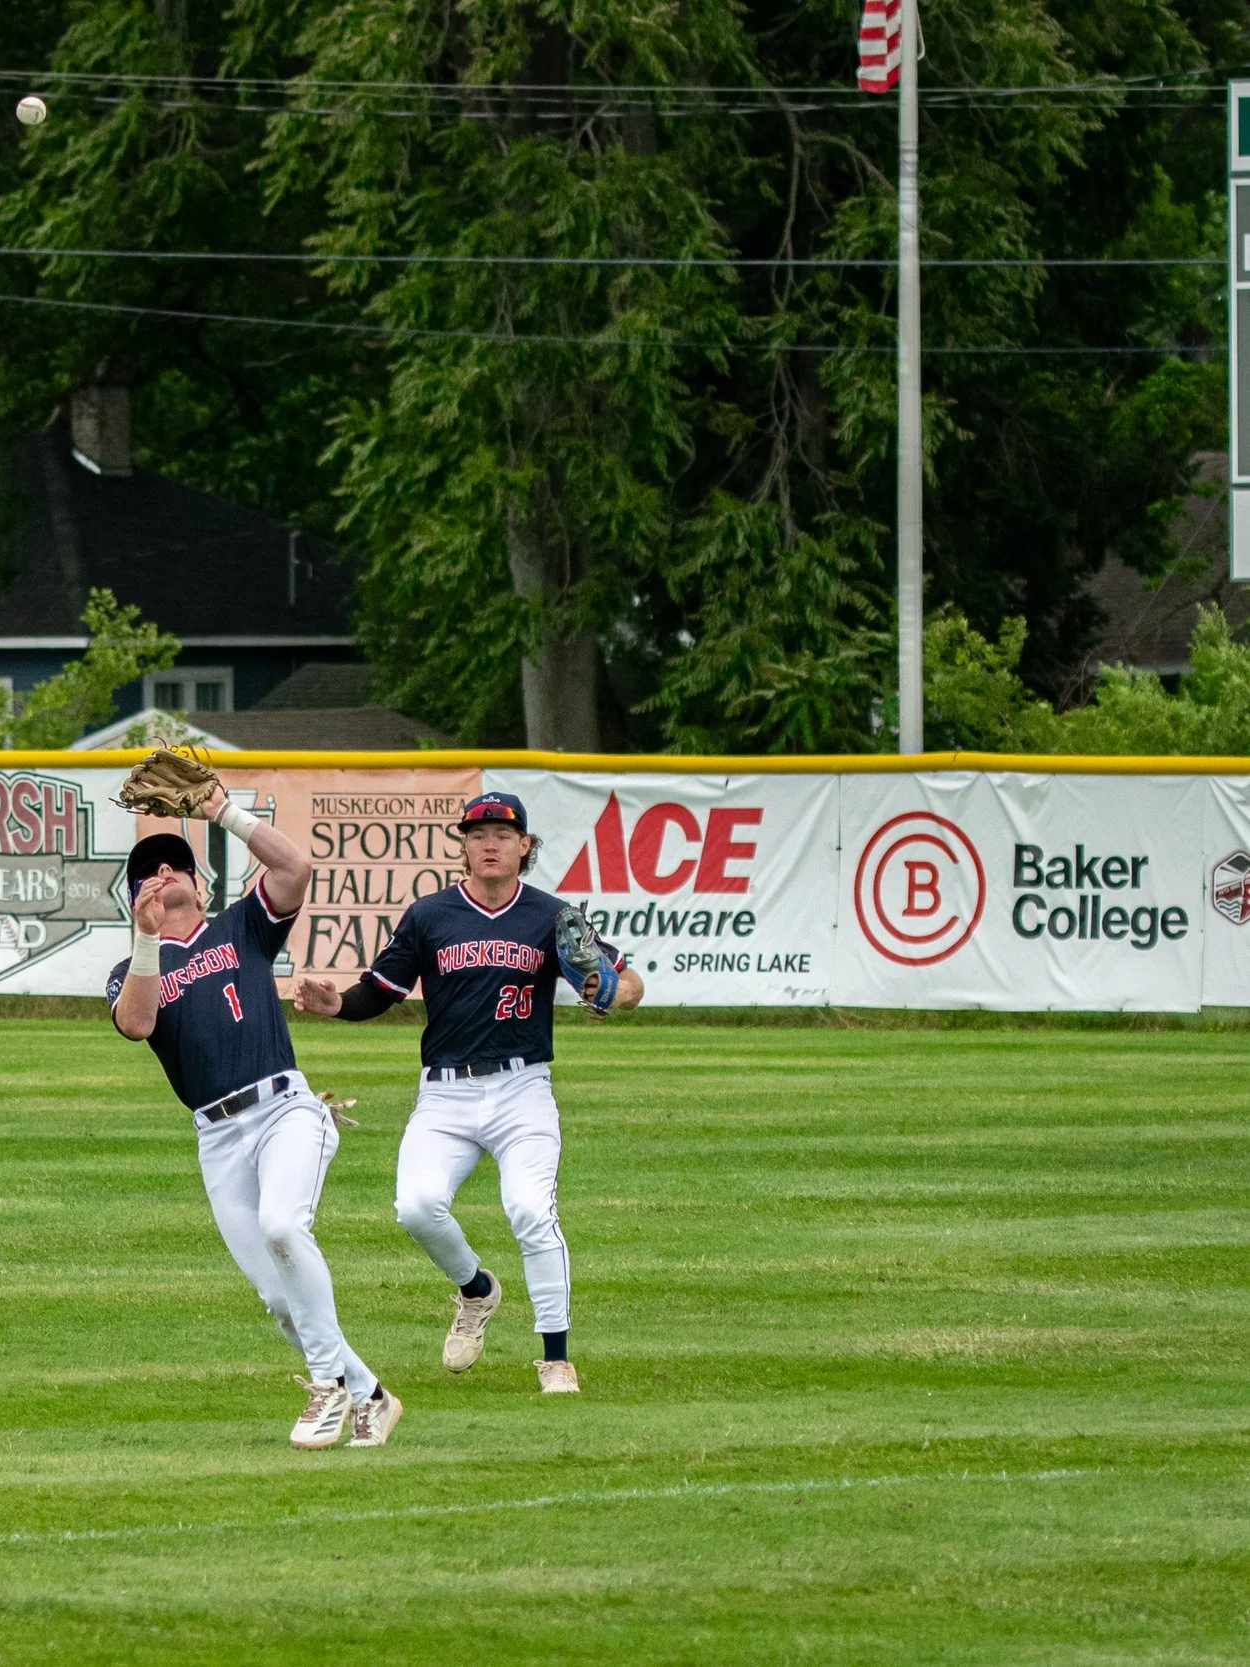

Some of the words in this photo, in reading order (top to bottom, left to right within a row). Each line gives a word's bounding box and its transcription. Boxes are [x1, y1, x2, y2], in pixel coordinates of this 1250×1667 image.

[312, 797, 420, 815] MUSKEGON
[422, 797, 466, 815] AREA
[310, 822, 464, 860] SPORTS
[555, 789, 765, 895] ACE
[1013, 843, 1150, 890] Baker
[66, 882, 101, 900] 2016
[309, 868, 407, 905] HALL
[586, 902, 757, 938] ardware
[1011, 893, 1189, 951] College
[437, 940, 545, 976] MUSKEGON
[673, 953, 751, 974] SPRING
[756, 953, 812, 974] LAKE
[222, 982, 244, 1023] 1
[494, 984, 535, 1020] 20
